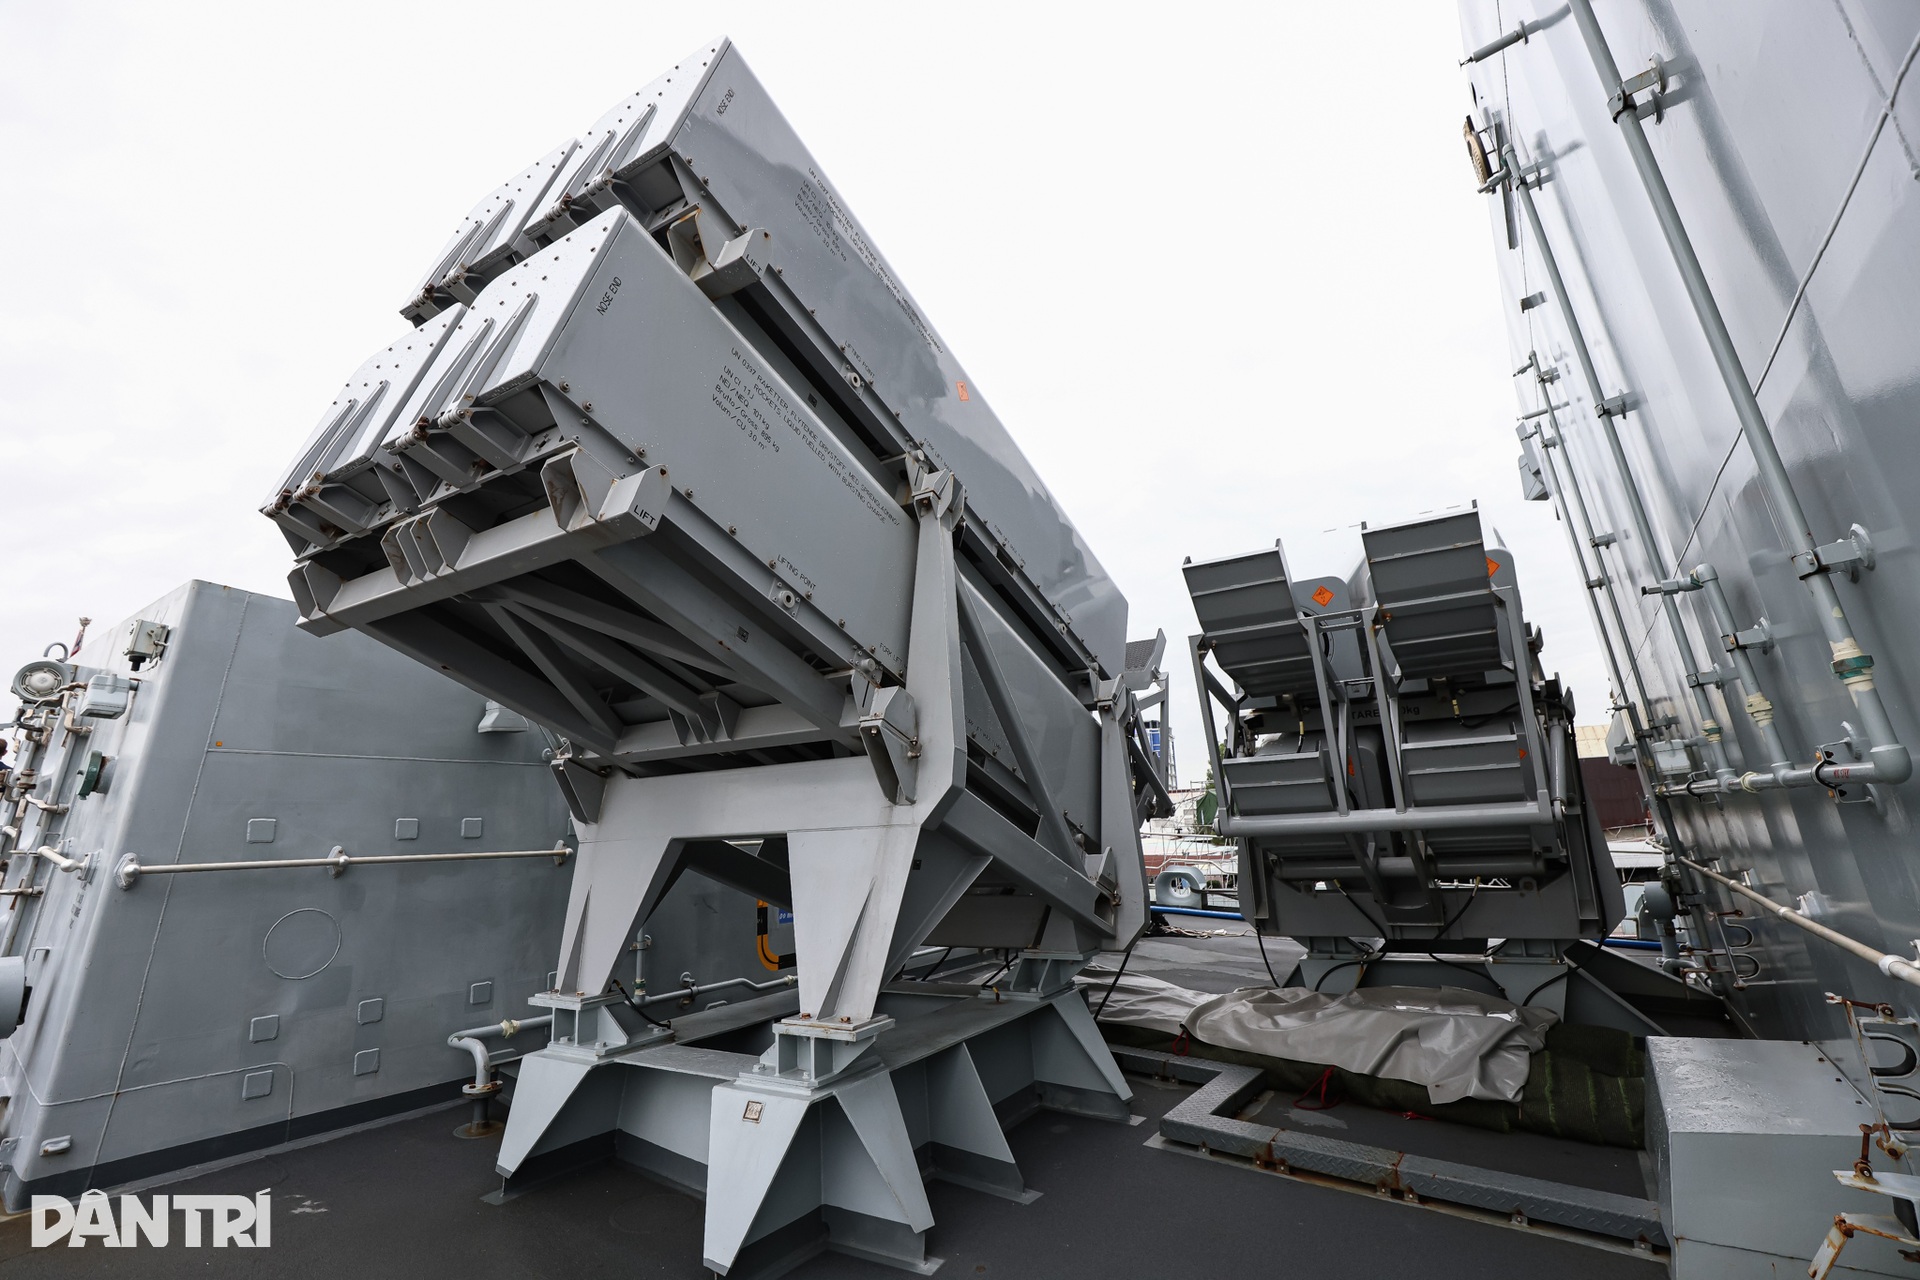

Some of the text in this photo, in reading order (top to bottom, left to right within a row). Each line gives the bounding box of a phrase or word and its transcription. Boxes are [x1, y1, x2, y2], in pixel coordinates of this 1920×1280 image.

[746, 254, 762, 273] LIFT
[596, 276, 622, 316] NOSE END
[731, 347, 741, 360] UN
[723, 365, 734, 379] UN
[783, 415, 801, 436] LIQUID
[772, 440, 780, 453] kg
[633, 504, 656, 525] LIFT
[777, 554, 816, 590] LIFTING POINT
